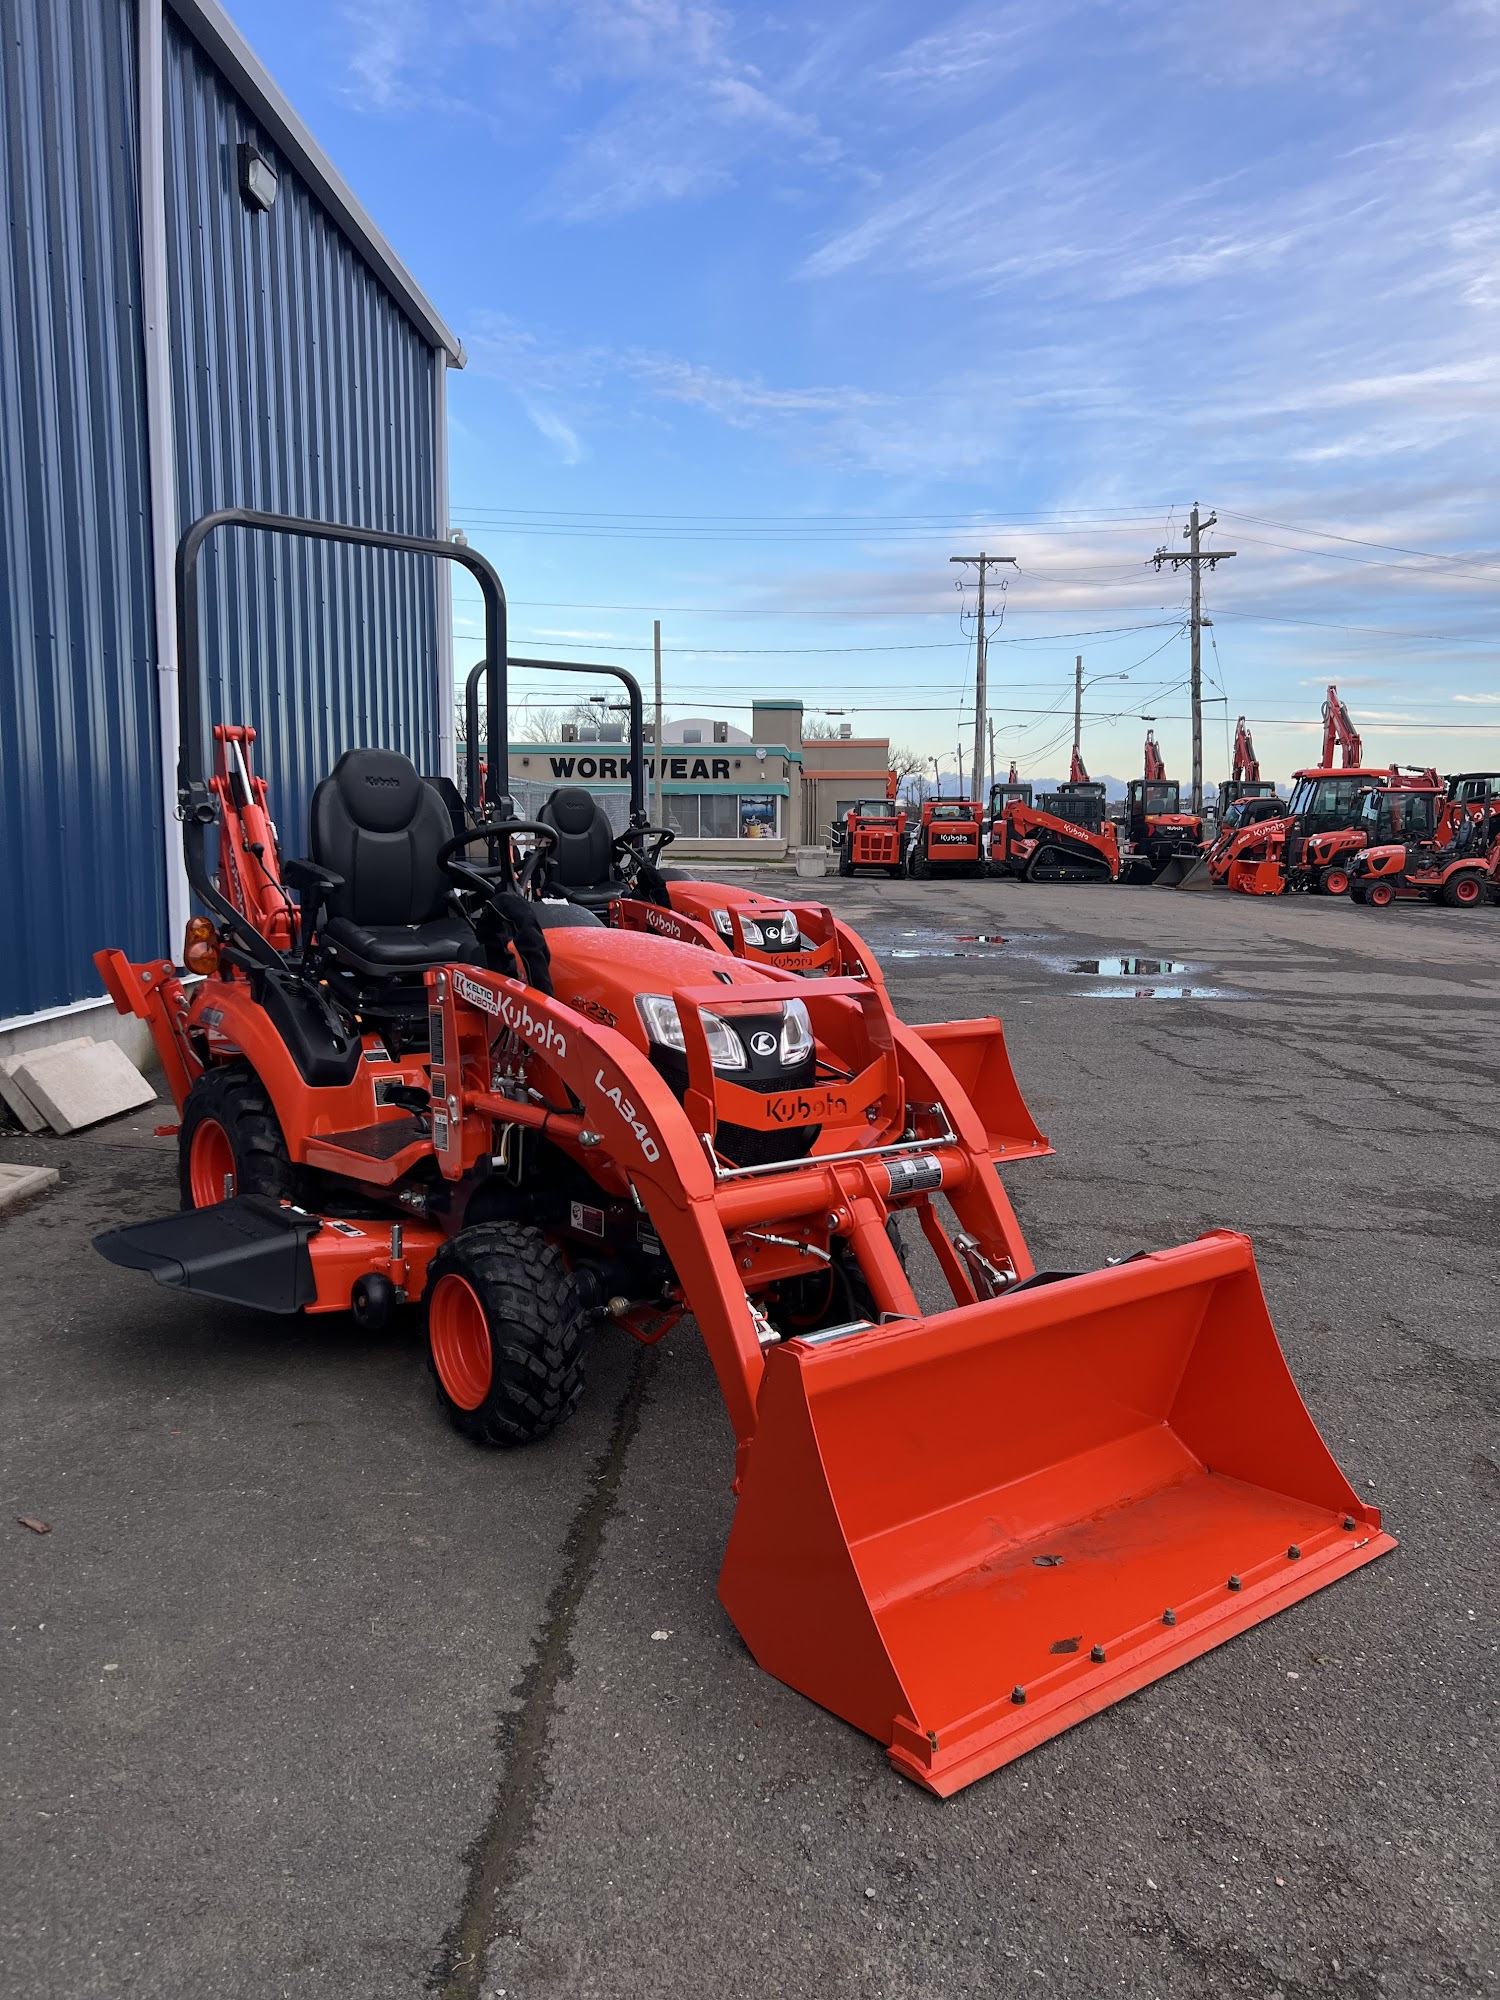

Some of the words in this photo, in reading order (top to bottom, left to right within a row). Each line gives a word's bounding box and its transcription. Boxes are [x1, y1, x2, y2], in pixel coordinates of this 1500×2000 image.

[940, 834, 968, 842] Kubota
[1063, 823, 1089, 840] Kubota
[1253, 823, 1285, 837] Kubota
[646, 908, 681, 938] Kubota
[770, 955, 813, 969] Kubota
[466, 981, 492, 1001] KELTIC
[466, 990, 499, 1015] KUBOTA
[571, 995, 619, 1027] BX23S
[498, 991, 567, 1058] Kubota
[594, 1068, 660, 1163] LA340
[766, 1092, 847, 1123] Kubota
